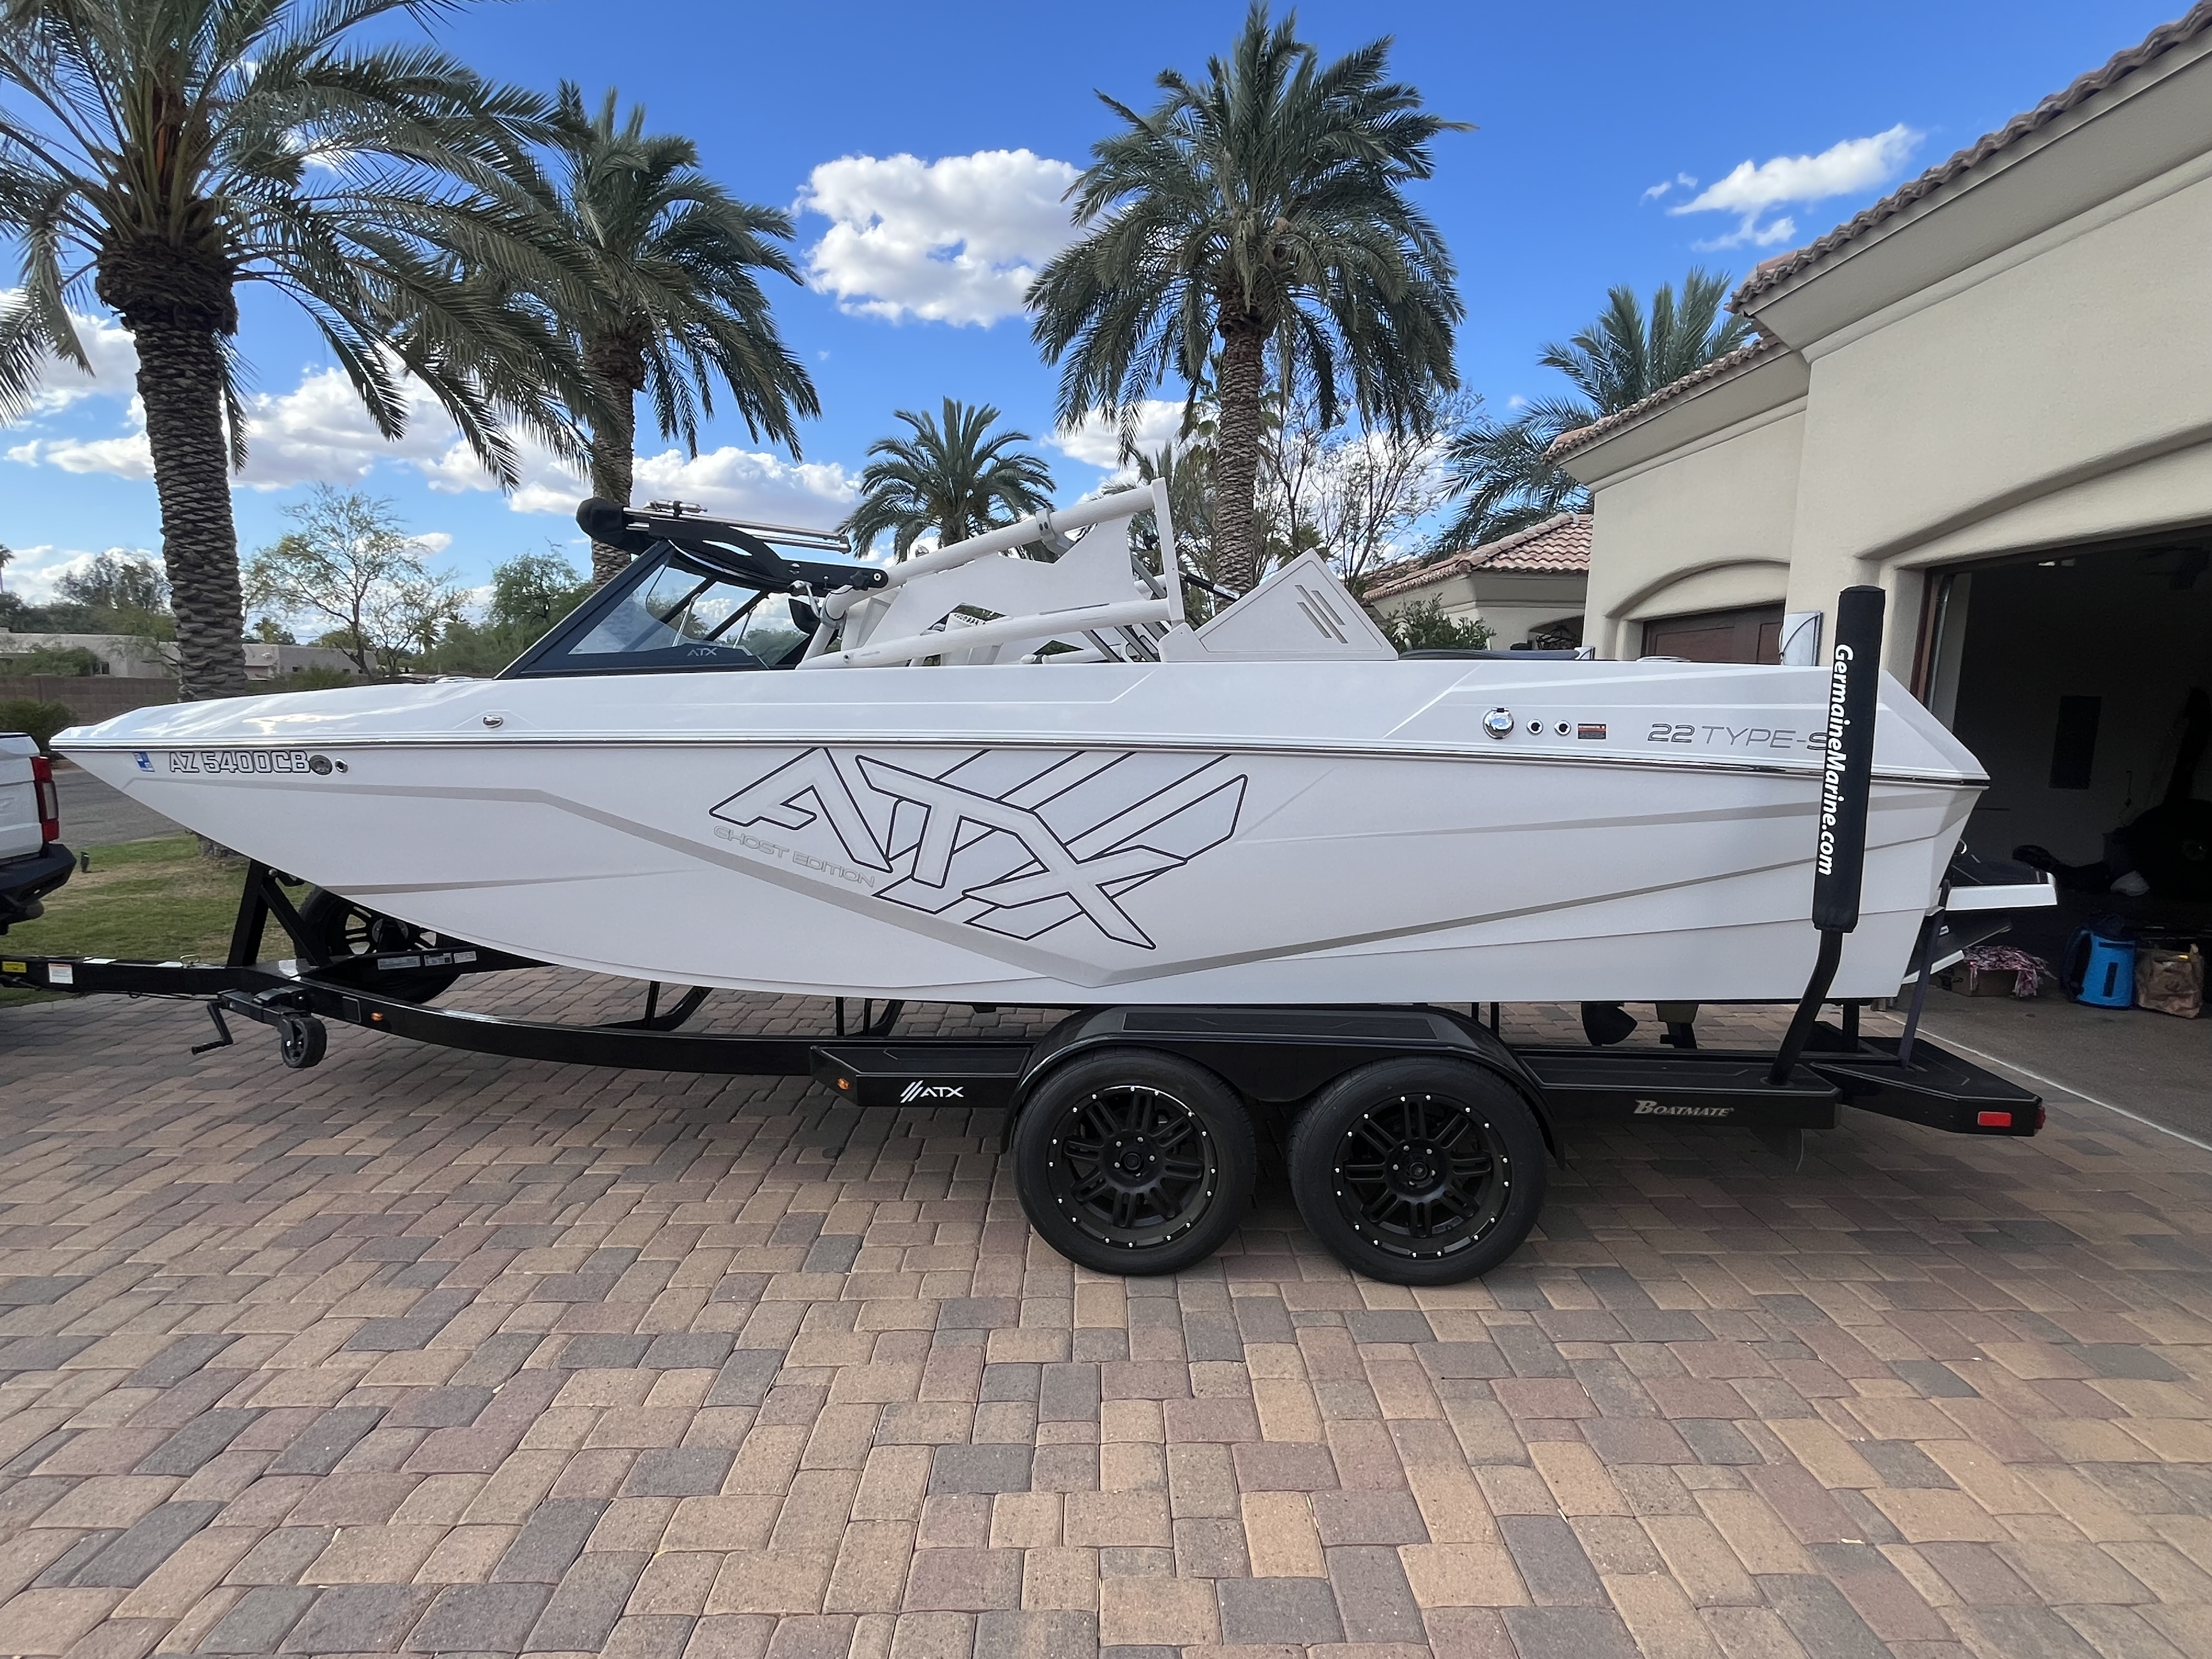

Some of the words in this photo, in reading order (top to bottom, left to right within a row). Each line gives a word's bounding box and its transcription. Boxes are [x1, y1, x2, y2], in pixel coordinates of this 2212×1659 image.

[687, 647, 718, 657] ATX
[1647, 723, 1695, 743] 22
[1701, 725, 1829, 751] TYPE-S
[169, 751, 199, 773] AZ
[201, 751, 311, 774] 5400CB
[1818, 644, 1853, 876] GermaineMarine.com
[709, 746, 1188, 950] ATX
[714, 825, 789, 859] GHOST
[792, 851, 876, 888] EDITION
[919, 1086, 964, 1098] ATX
